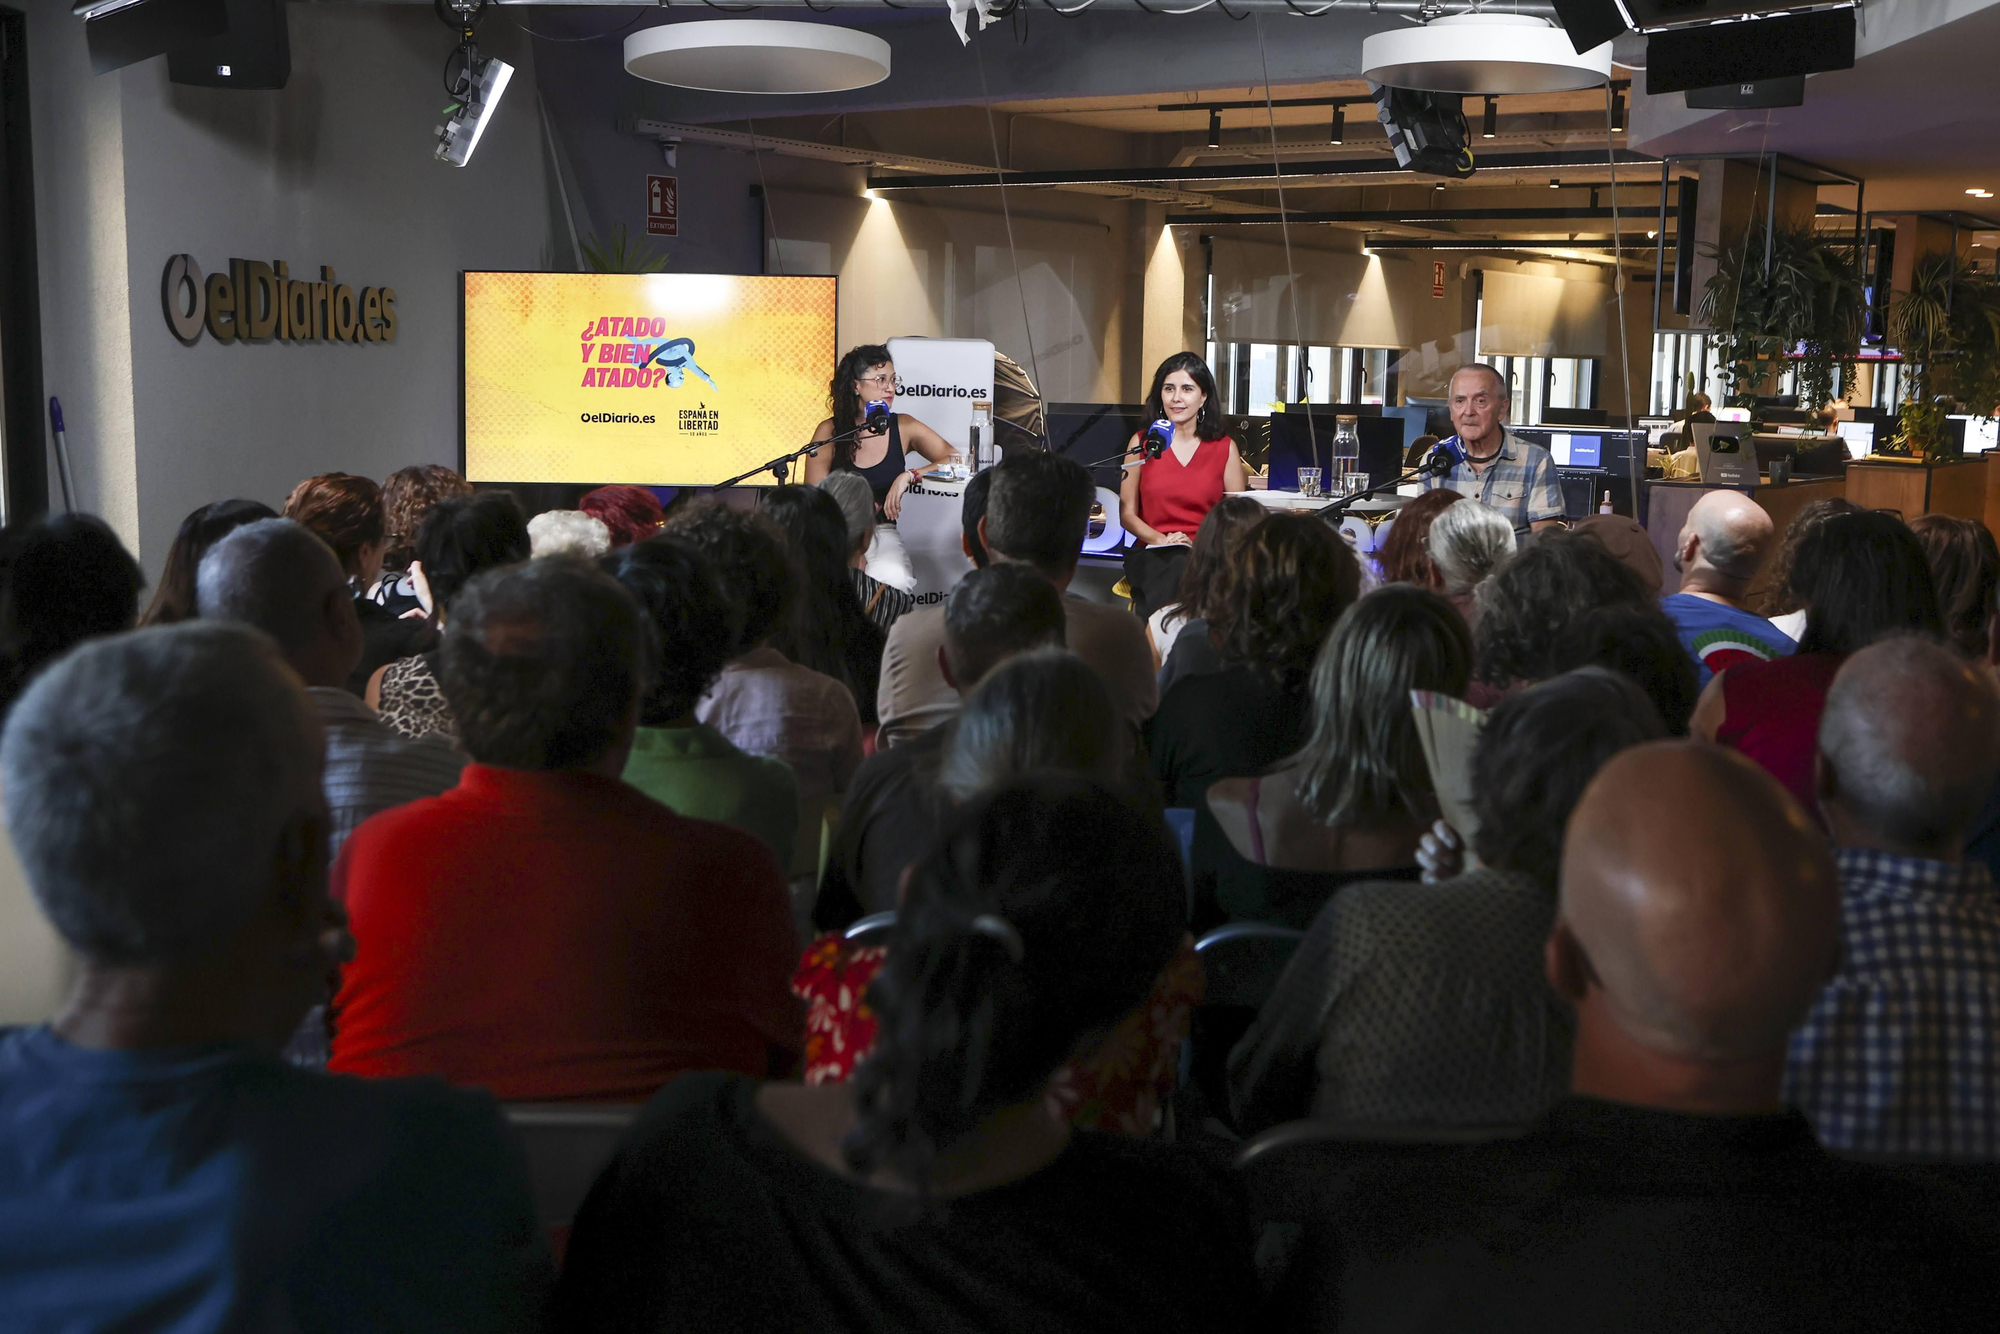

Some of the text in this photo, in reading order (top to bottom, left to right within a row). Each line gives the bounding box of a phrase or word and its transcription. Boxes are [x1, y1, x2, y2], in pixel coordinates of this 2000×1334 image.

[650, 222, 676, 230] EXTINTOR
[581, 317, 666, 341] ¿ATADO
[581, 343, 651, 363] Y BIEN
[581, 367, 666, 388] ATADO?
[709, 410, 718, 419] EN
[679, 420, 718, 430] LIBERTAD
